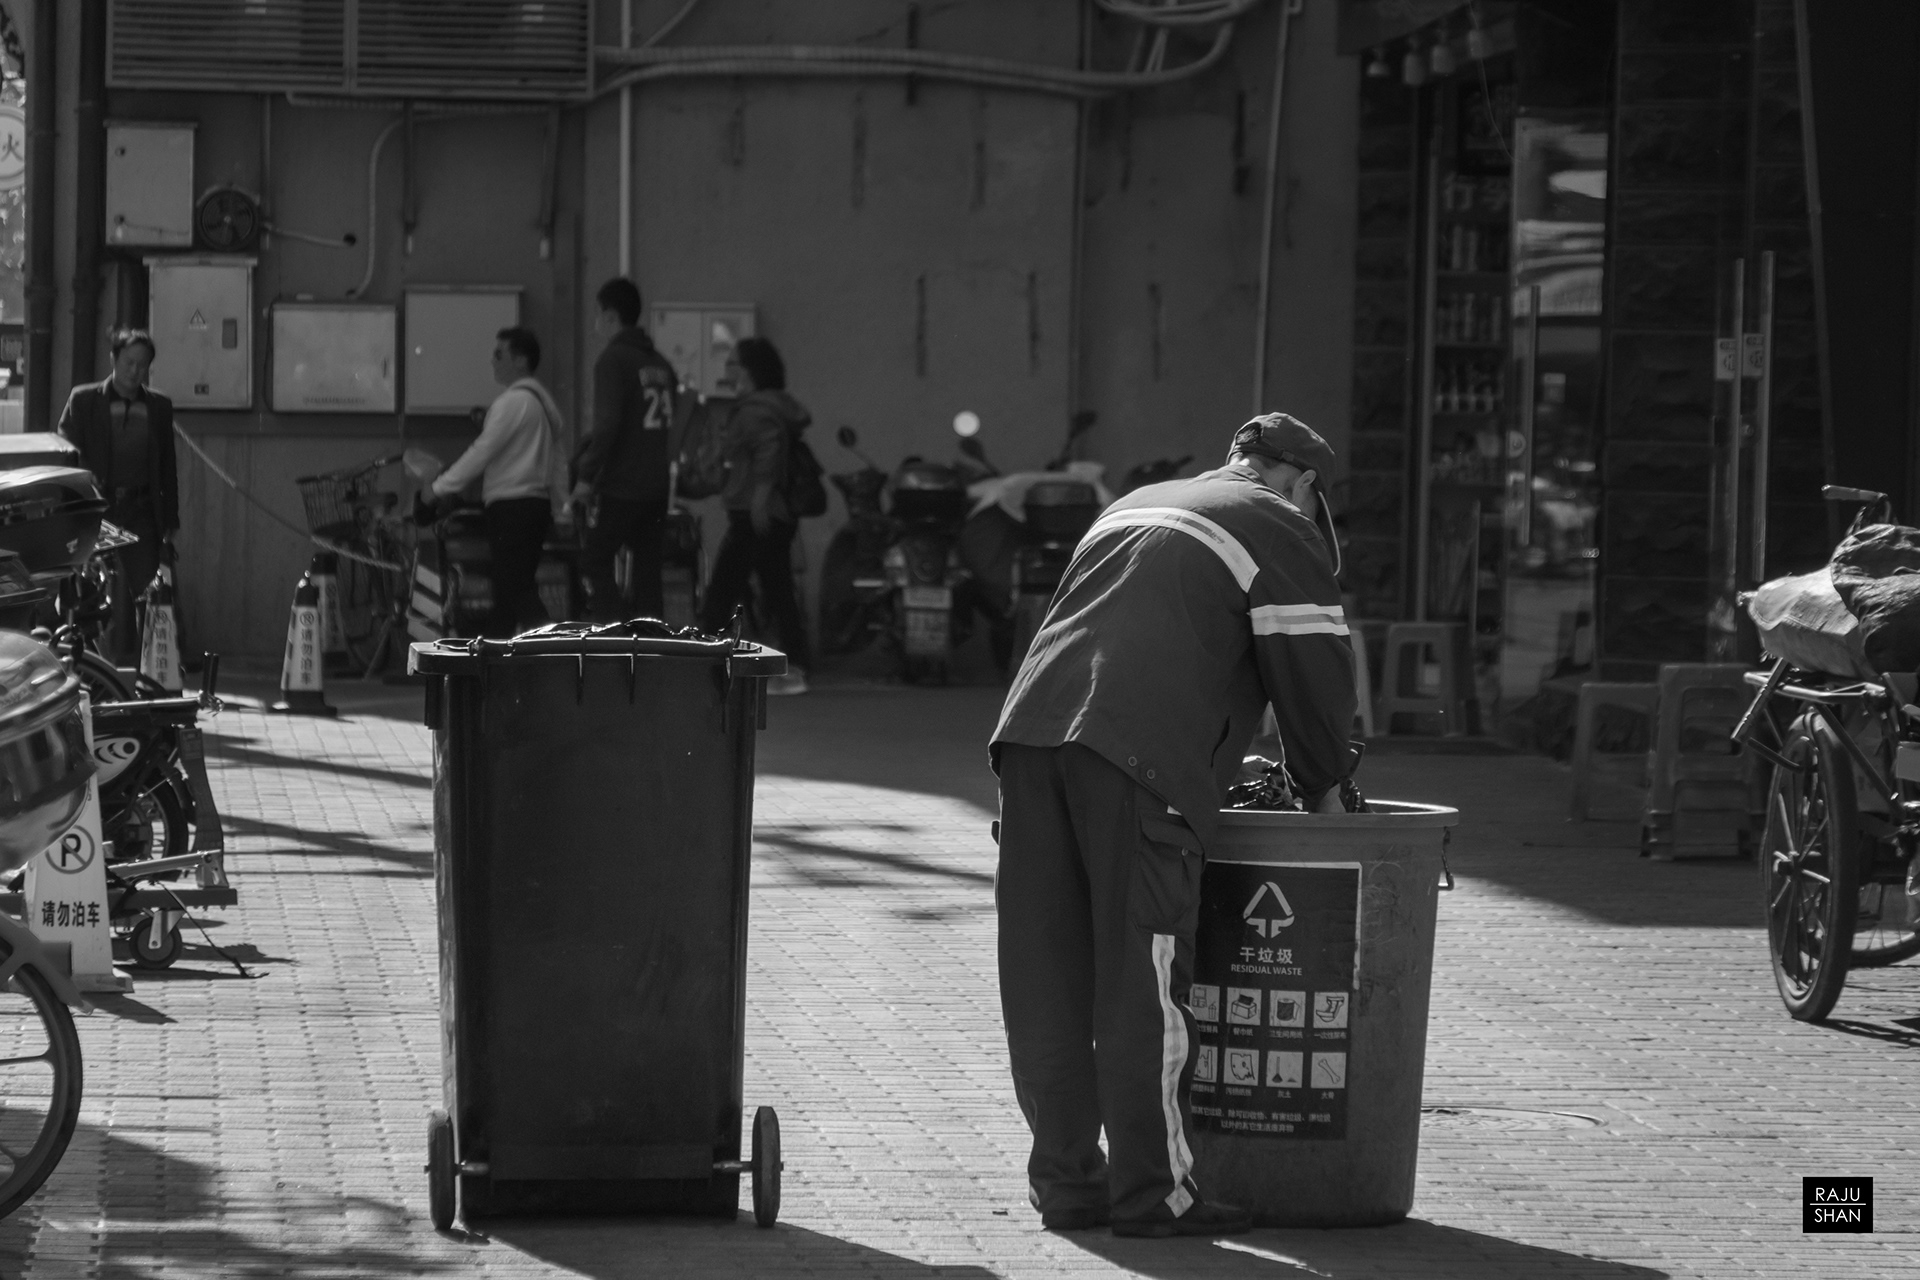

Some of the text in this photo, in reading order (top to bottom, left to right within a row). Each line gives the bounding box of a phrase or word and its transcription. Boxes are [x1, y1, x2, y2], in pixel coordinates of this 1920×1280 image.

[42, 900, 100, 928] 请勿泊车
[1239, 946, 1293, 965] 干垃圾
[1230, 964, 1303, 976] RESIDUAL WASTE
